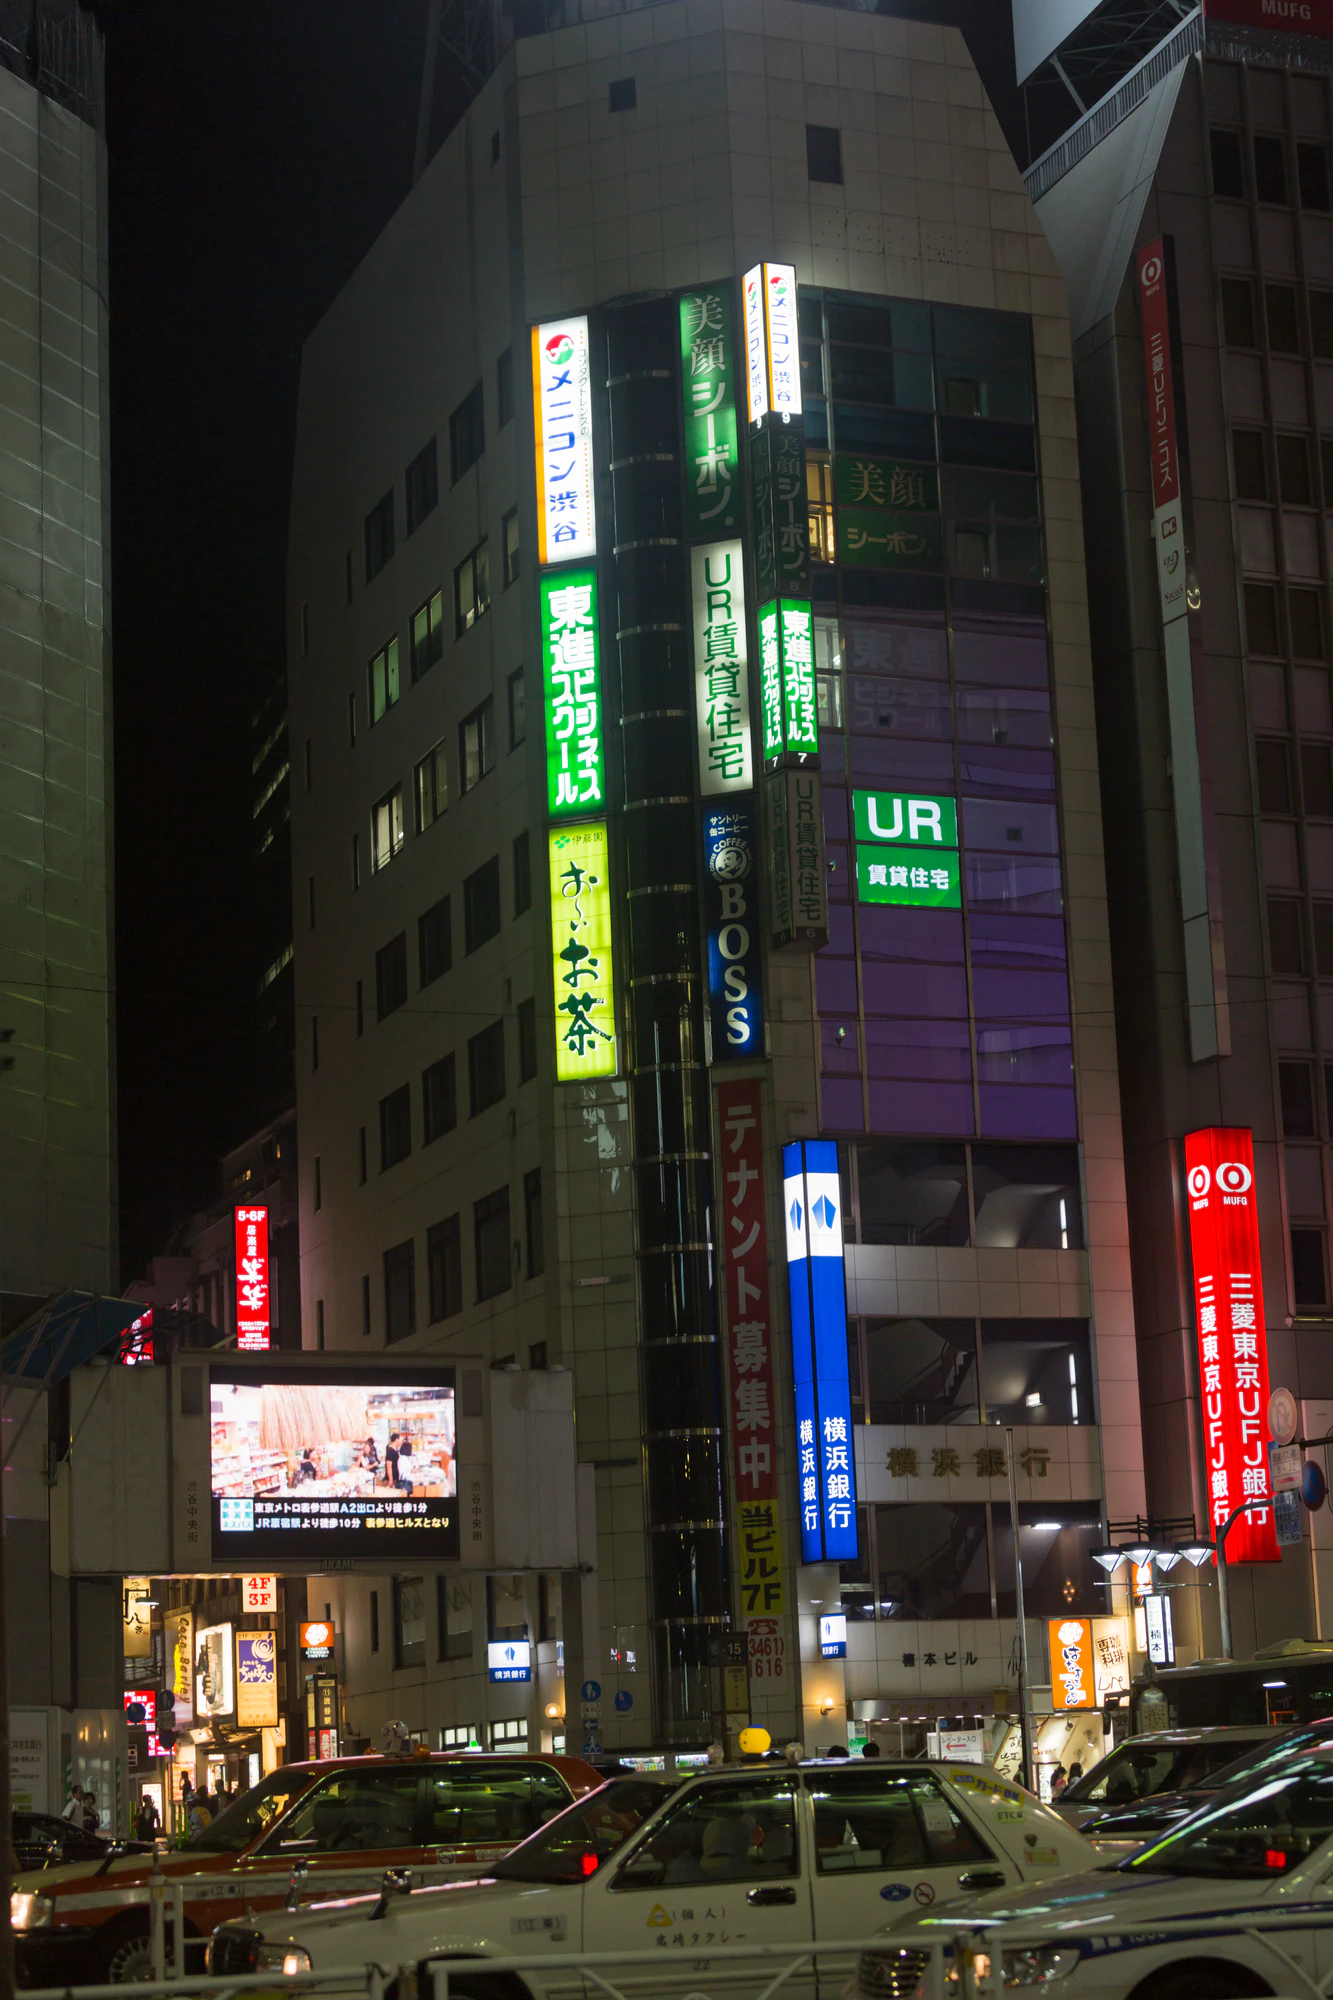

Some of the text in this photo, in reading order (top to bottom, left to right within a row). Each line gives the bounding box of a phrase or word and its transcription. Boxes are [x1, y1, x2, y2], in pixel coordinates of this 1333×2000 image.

[1261, 0, 1311, 20] MUFG
[749, 300, 763, 407] メニコン渋谷
[771, 297, 791, 402] メニコン渋谷
[577, 349, 589, 436] コンタクトレンズの
[756, 416, 763, 429] 9
[782, 411, 791, 424] 9
[1149, 332, 1173, 489] 三菱UFJニコス
[547, 369, 578, 543] メニコン渋谷
[848, 461, 927, 508] 美顔
[790, 580, 799, 592] 8
[547, 585, 595, 674] 東進
[760, 613, 778, 671] 東進
[782, 610, 811, 663] 東進
[702, 553, 745, 780] UR賃貸住宅
[785, 661, 801, 742] スクール
[799, 660, 816, 743] ビジネス
[551, 673, 578, 806] スクール
[574, 669, 601, 802] ビジネス
[772, 756, 779, 767] 7
[797, 753, 808, 763] 7
[709, 813, 748, 826] サントリー
[709, 824, 749, 837] 缶コーヒー
[866, 797, 943, 841] UR
[571, 832, 604, 846] 伊藤園
[713, 837, 749, 853] COFFEE
[771, 782, 789, 924] UR賃貸住宅
[795, 778, 821, 922] UR賃貸住宅
[868, 864, 950, 890] 賃貸住宅
[780, 932, 786, 942] 6
[805, 928, 816, 938] 6
[718, 883, 751, 1044] BOSS
[1193, 1198, 1209, 1210] MUFG
[1223, 1196, 1248, 1206] MUFG
[724, 1104, 773, 1490] テナント募集中
[1199, 1275, 1230, 1526] 三菱東京UFJ銀行
[1230, 1273, 1269, 1526] 三菱東京UFJ銀行
[800, 1419, 818, 1531] 横浜銀行
[823, 1416, 851, 1529] 横浜銀行
[887, 1447, 1054, 1478] 横浜銀行
[186, 1480, 198, 1544] 渋谷中央街
[254, 1502, 428, 1514] 東京メトロ表参道駅A2出口より徒歩1分
[255, 1517, 450, 1529] JR原宿駅より徒歩10分 表参道ヒルズとなり
[470, 1480, 483, 1542] 渋谷中央街
[248, 1578, 271, 1590] 4F
[248, 1593, 272, 1606] 3F
[727, 1643, 742, 1655] 15
[902, 1652, 978, 1668] 楠本ビル
[494, 1670, 527, 1680] 横浜銀行
[749, 1657, 783, 1678] 1616
[323, 1697, 332, 1725] 渋谷駅
[940, 1735, 977, 1744] レベーター入口
